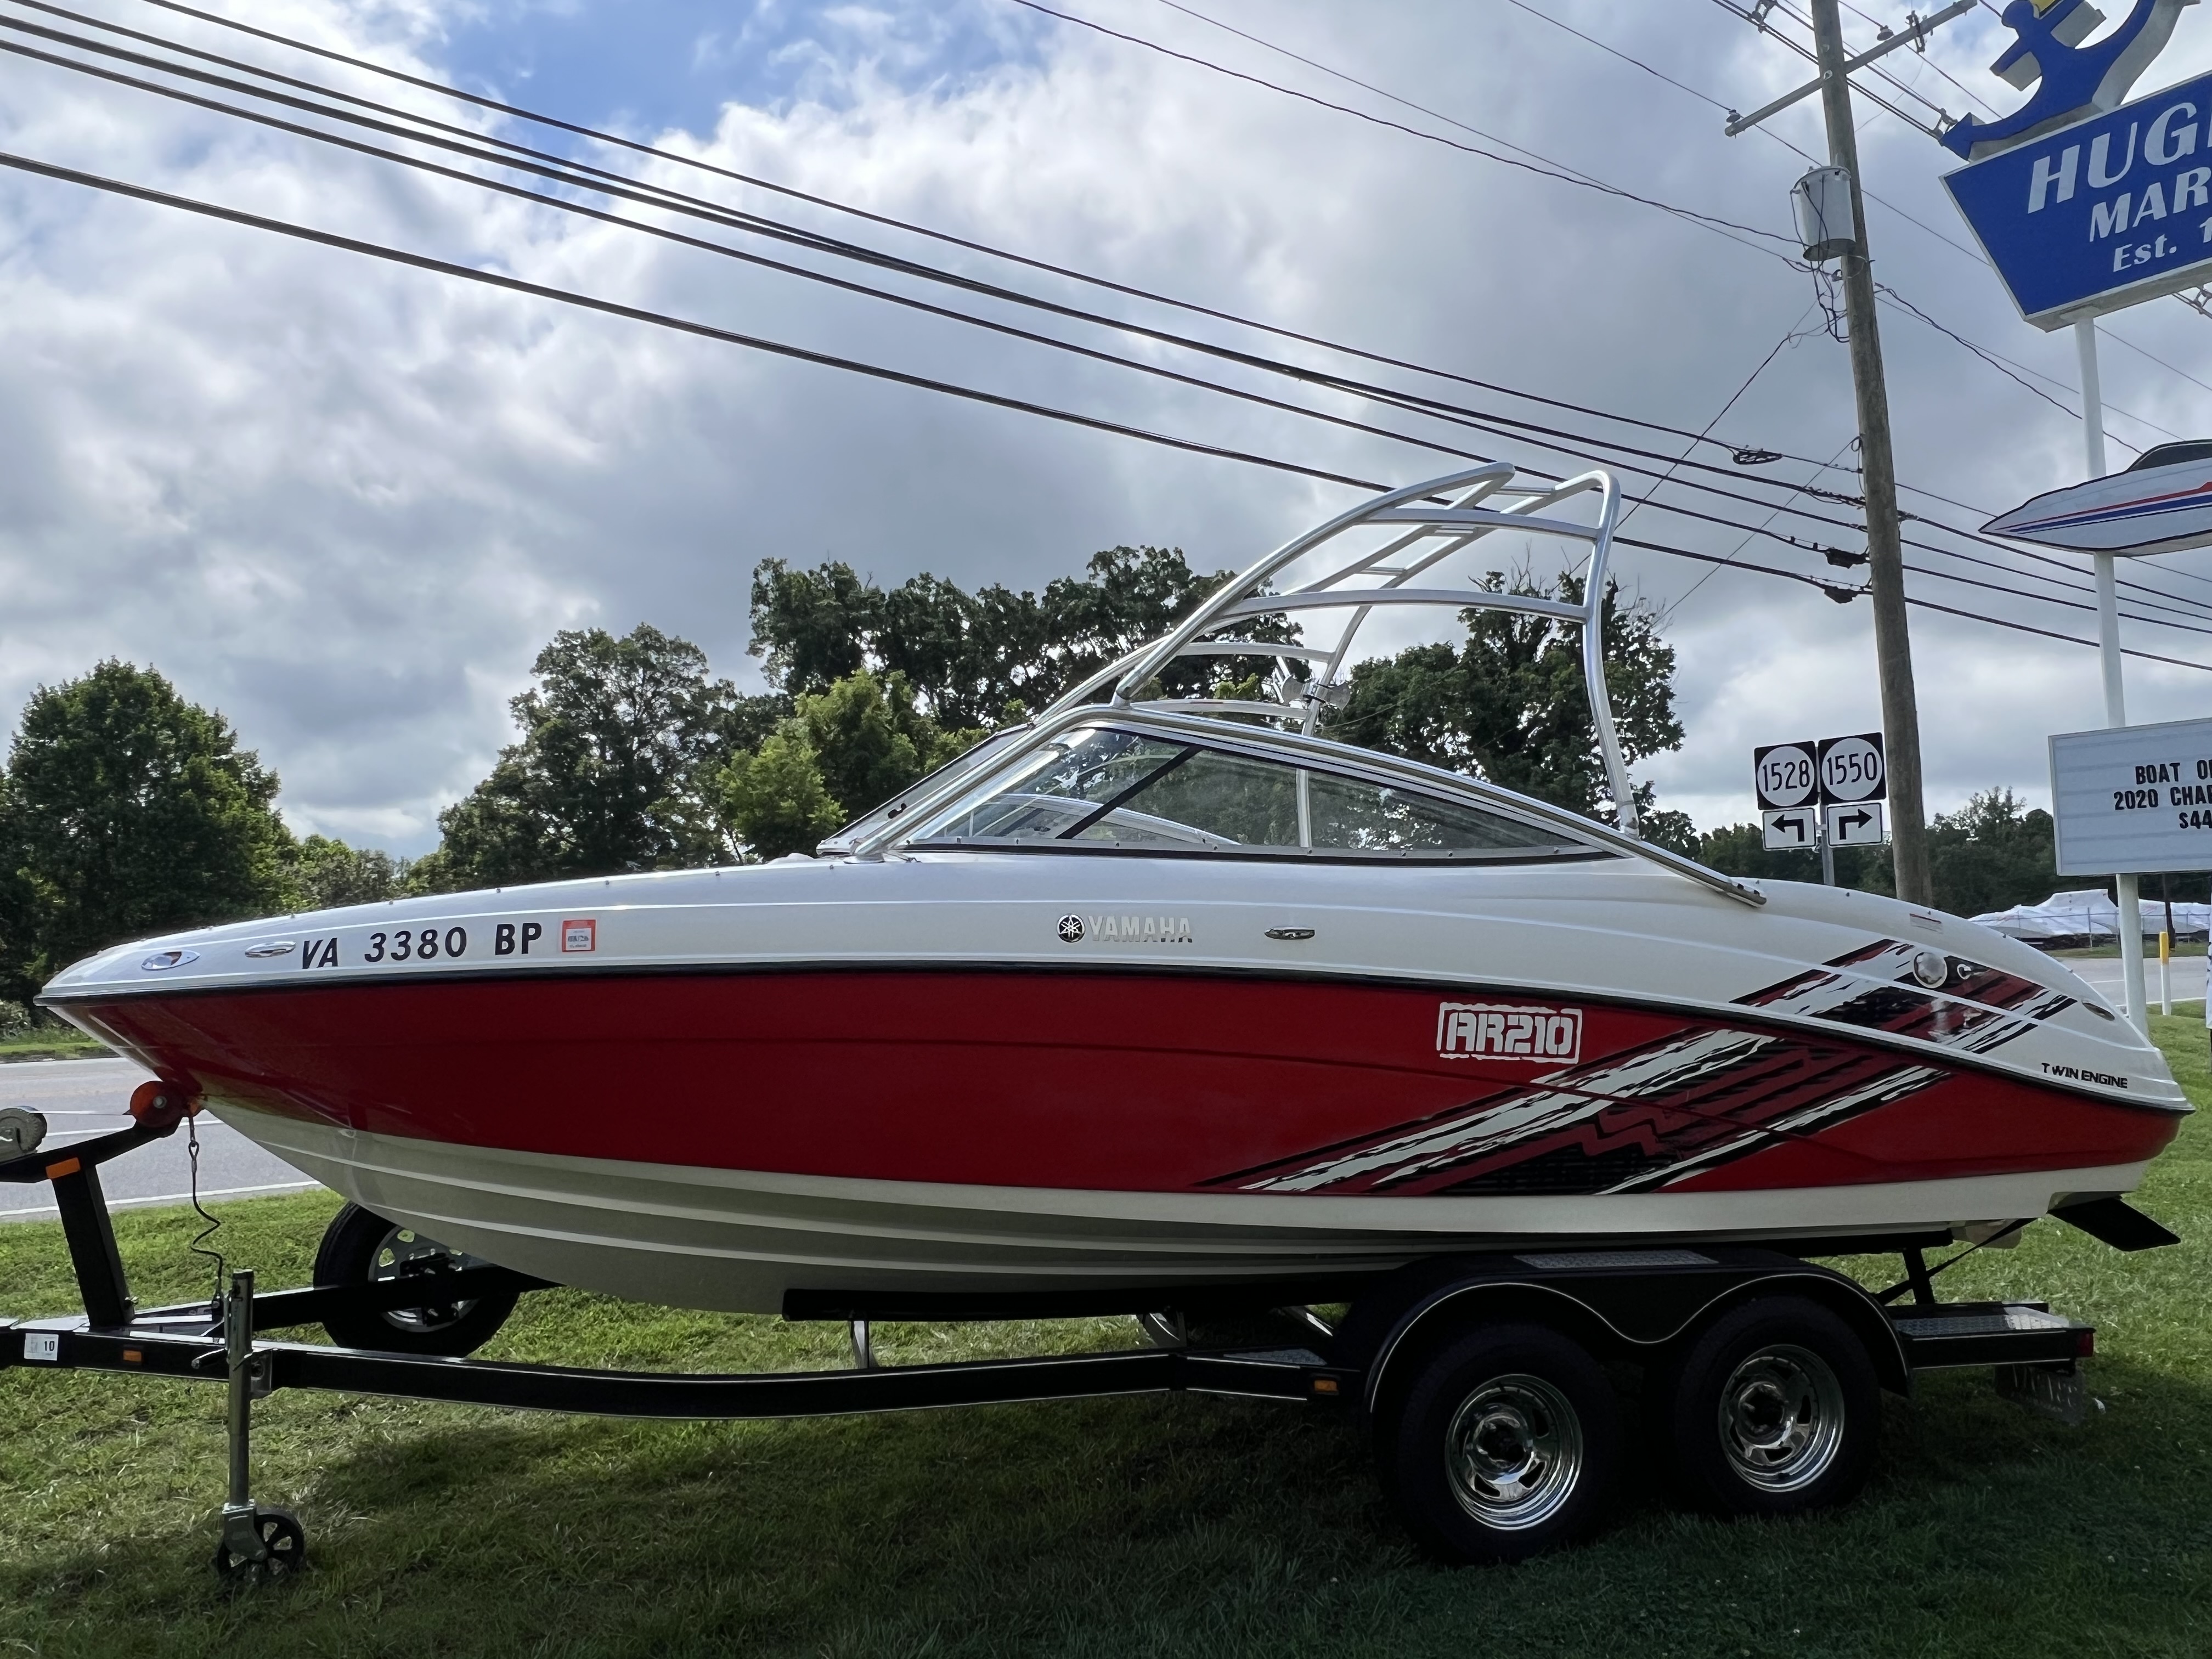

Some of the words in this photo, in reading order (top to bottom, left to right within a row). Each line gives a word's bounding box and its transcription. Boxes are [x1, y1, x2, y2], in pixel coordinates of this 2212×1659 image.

[2028, 102, 2212, 214] HUG
[2090, 167, 2211, 242] MAR
[2113, 234, 2177, 273] Est.
[1763, 760, 1810, 792] 1528
[1827, 752, 1877, 786] 1550
[2135, 763, 2181, 785] BOAT
[2114, 788, 2159, 810] 2020
[302, 938, 338, 969] VA
[364, 927, 467, 963] 3380
[495, 923, 542, 955] BP
[1088, 916, 1193, 943] YAMAHA
[1446, 1012, 1573, 1055] AR210
[2081, 1070, 2128, 1089] ENGINE
[44, 1340, 55, 1351] 10
